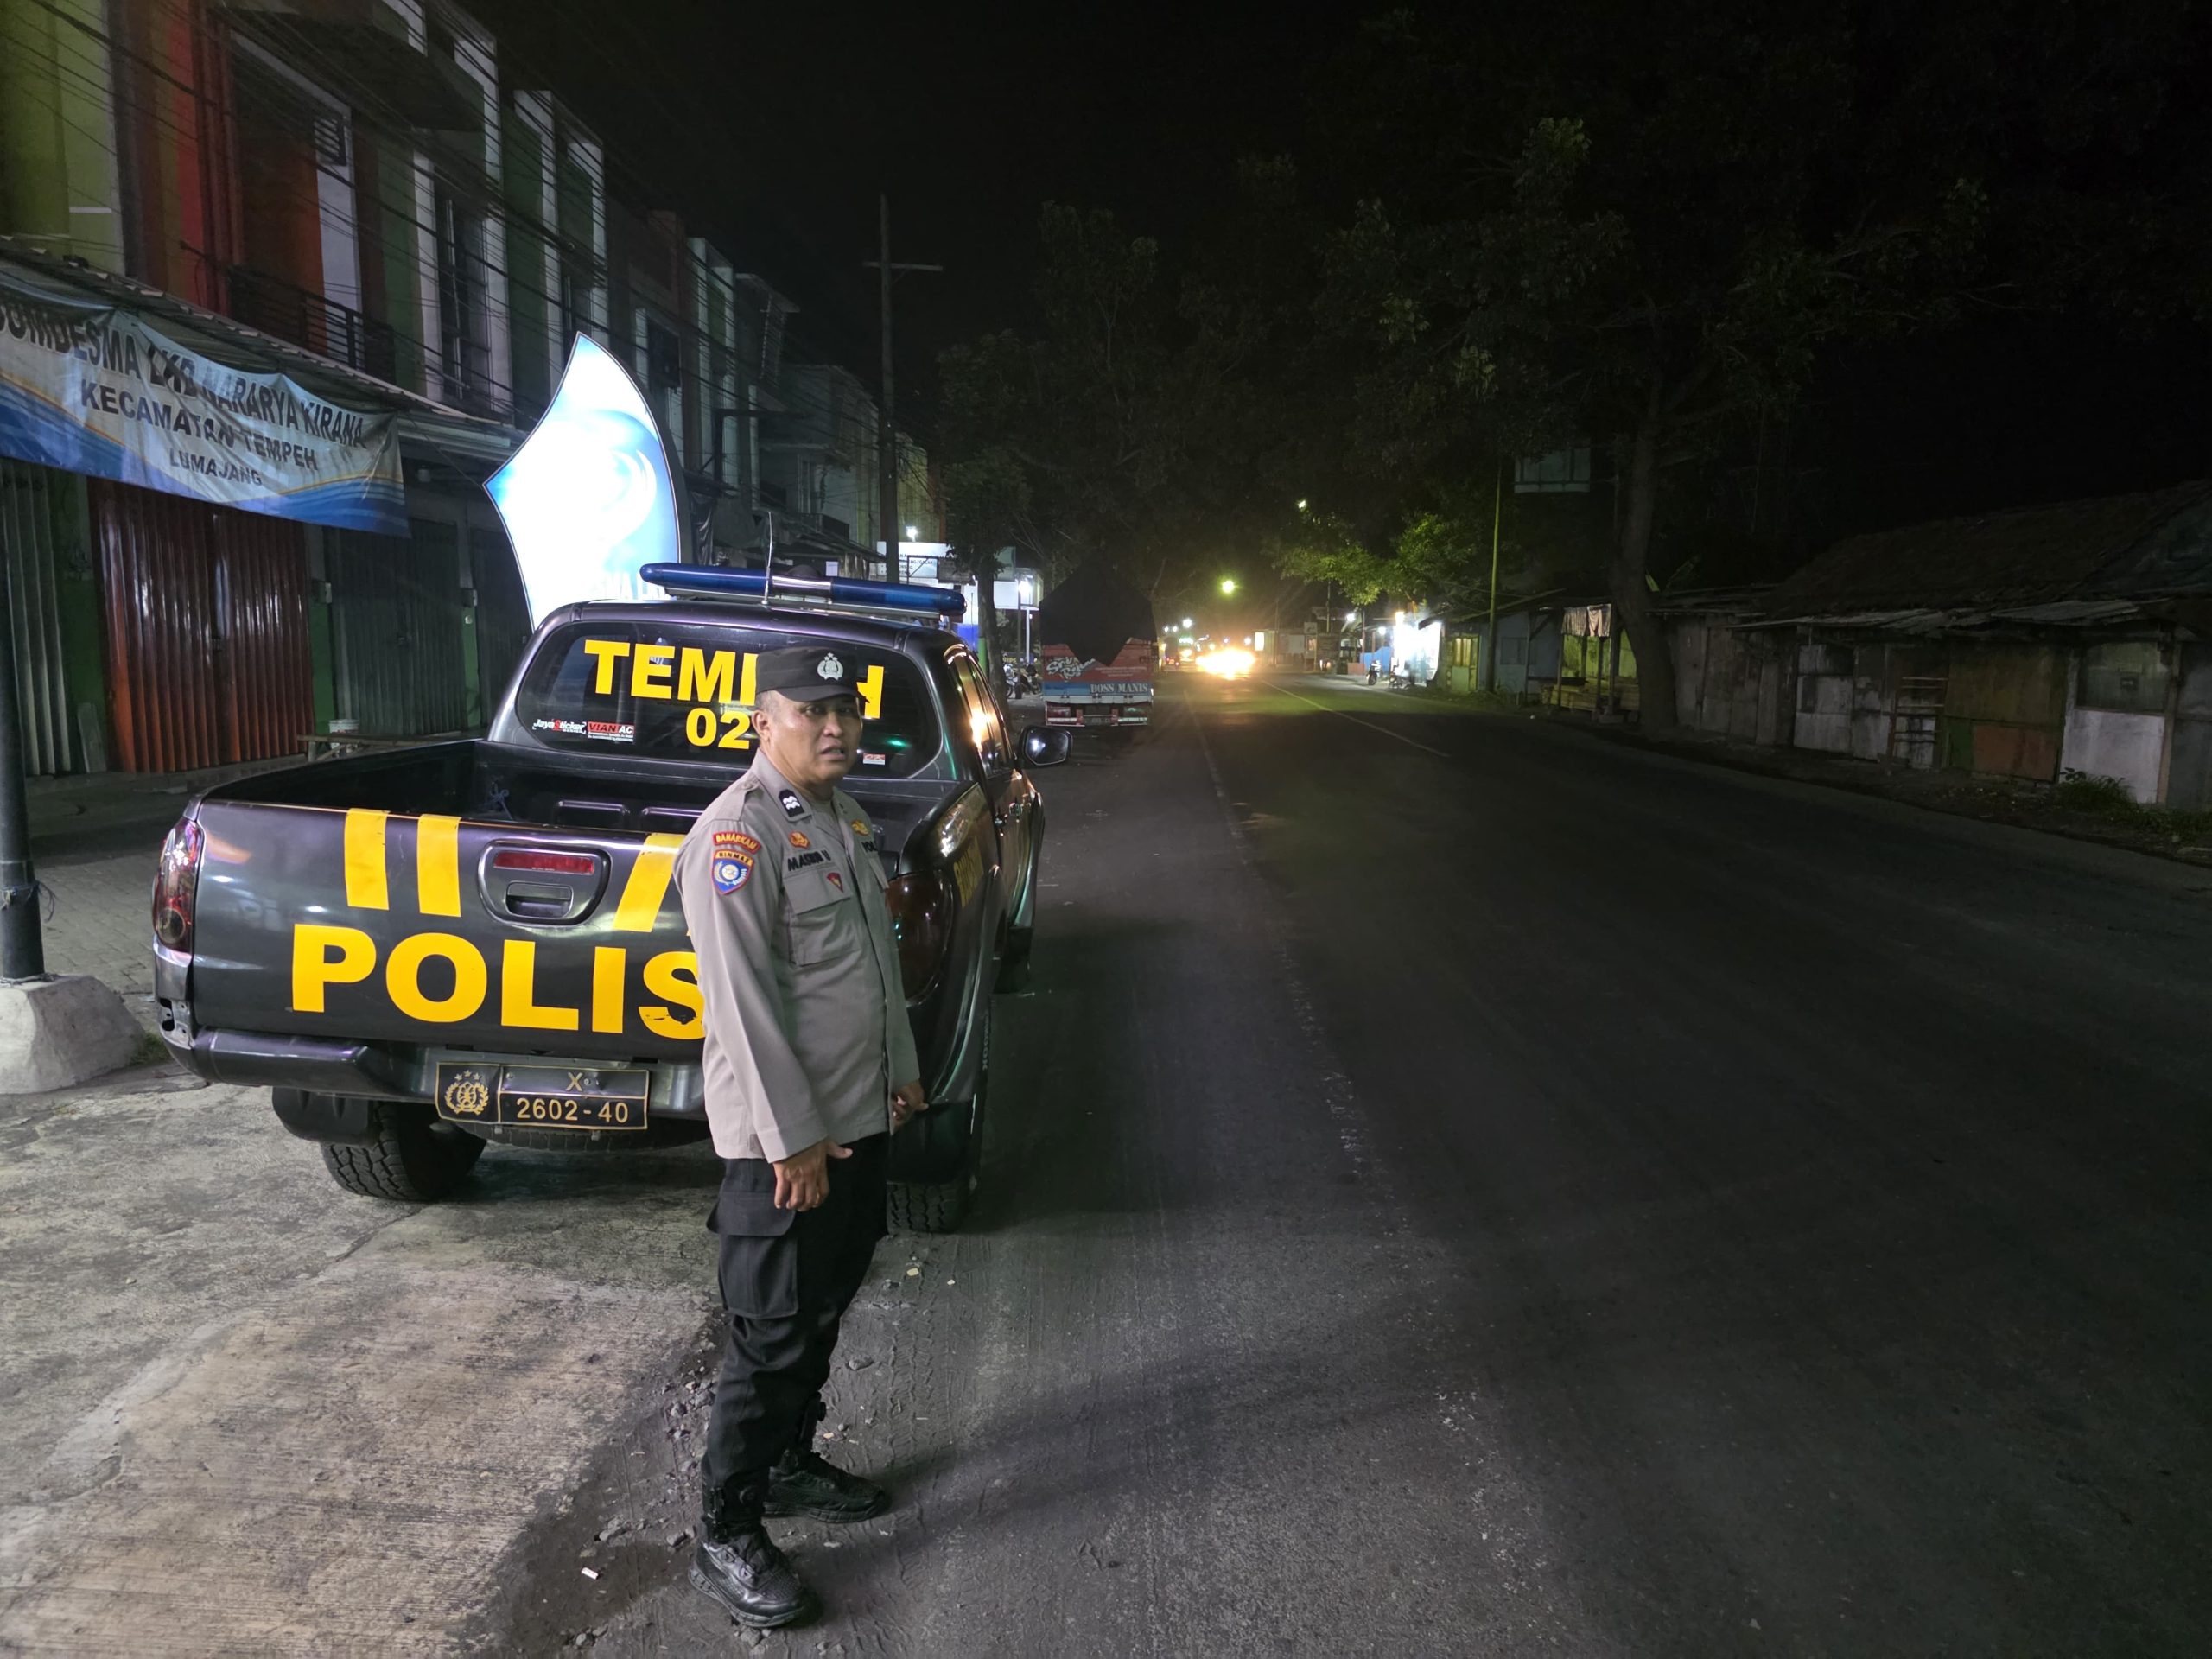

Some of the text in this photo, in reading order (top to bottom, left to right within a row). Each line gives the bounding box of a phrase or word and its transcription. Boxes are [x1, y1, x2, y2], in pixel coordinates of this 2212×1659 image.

[80, 379, 318, 471] KECAMATAN TEMPEH
[300, 400, 367, 449] KIRANA
[169, 448, 263, 486] LUMAJANG
[584, 639, 884, 720] TEMH
[1117, 683, 1148, 693] MANIS
[588, 722, 616, 733] VIAN
[618, 725, 634, 734] AC
[565, 1071, 584, 1092] X
[517, 1097, 629, 1123] 2602-40
